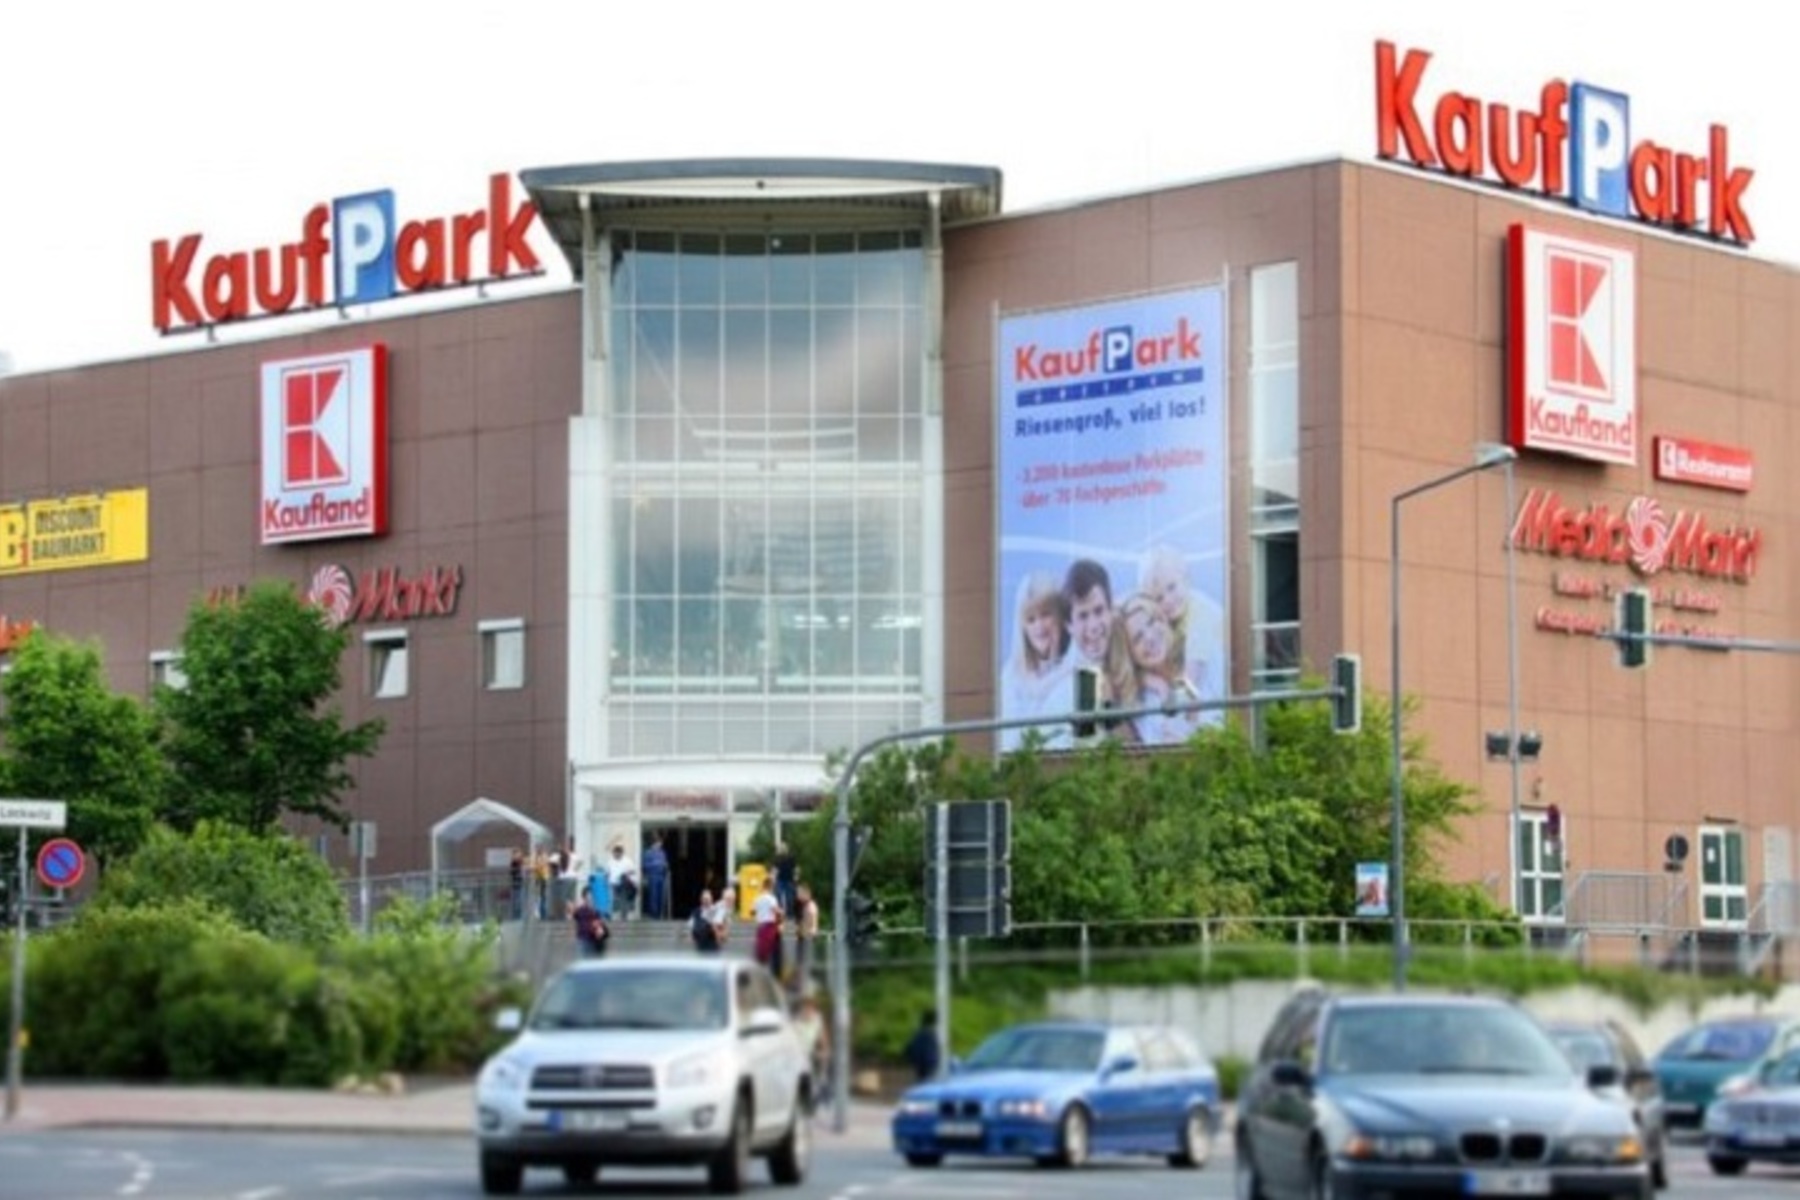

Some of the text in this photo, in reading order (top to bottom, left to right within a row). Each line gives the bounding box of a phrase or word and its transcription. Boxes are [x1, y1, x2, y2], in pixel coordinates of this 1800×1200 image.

[1375, 39, 1756, 243] KaufPark
[151, 172, 541, 331] KaufPark
[1015, 317, 1201, 382] KaufPark
[1015, 396, 1205, 438] Riesengroß, viel los!
[1529, 396, 1632, 446] Kaufland
[264, 486, 371, 530] Kaufland
[352, 563, 461, 622] Markt
